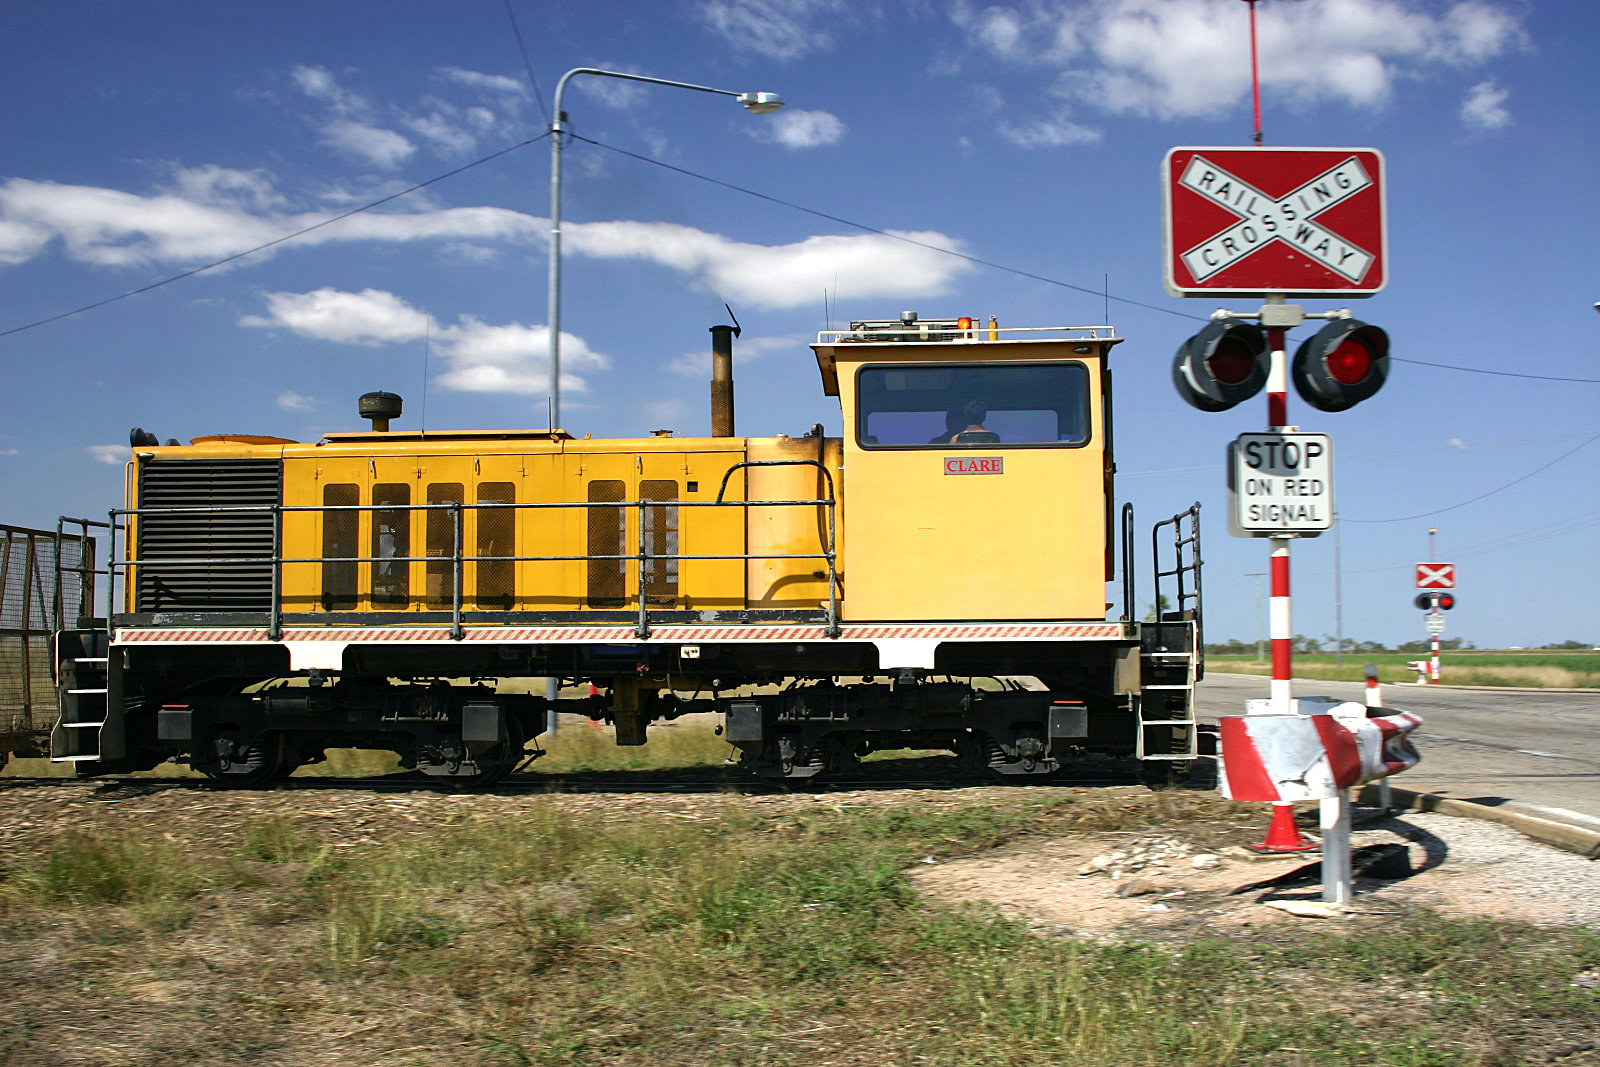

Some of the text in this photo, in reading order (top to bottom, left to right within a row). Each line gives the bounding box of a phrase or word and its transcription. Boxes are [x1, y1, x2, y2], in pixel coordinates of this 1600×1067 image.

[1202, 171, 1352, 267] CROSSING
[1245, 441, 1323, 469] STOP
[946, 459, 1001, 472] CLARE
[1245, 478, 1324, 496] ON RED
[1248, 504, 1323, 522] SIGNAL
